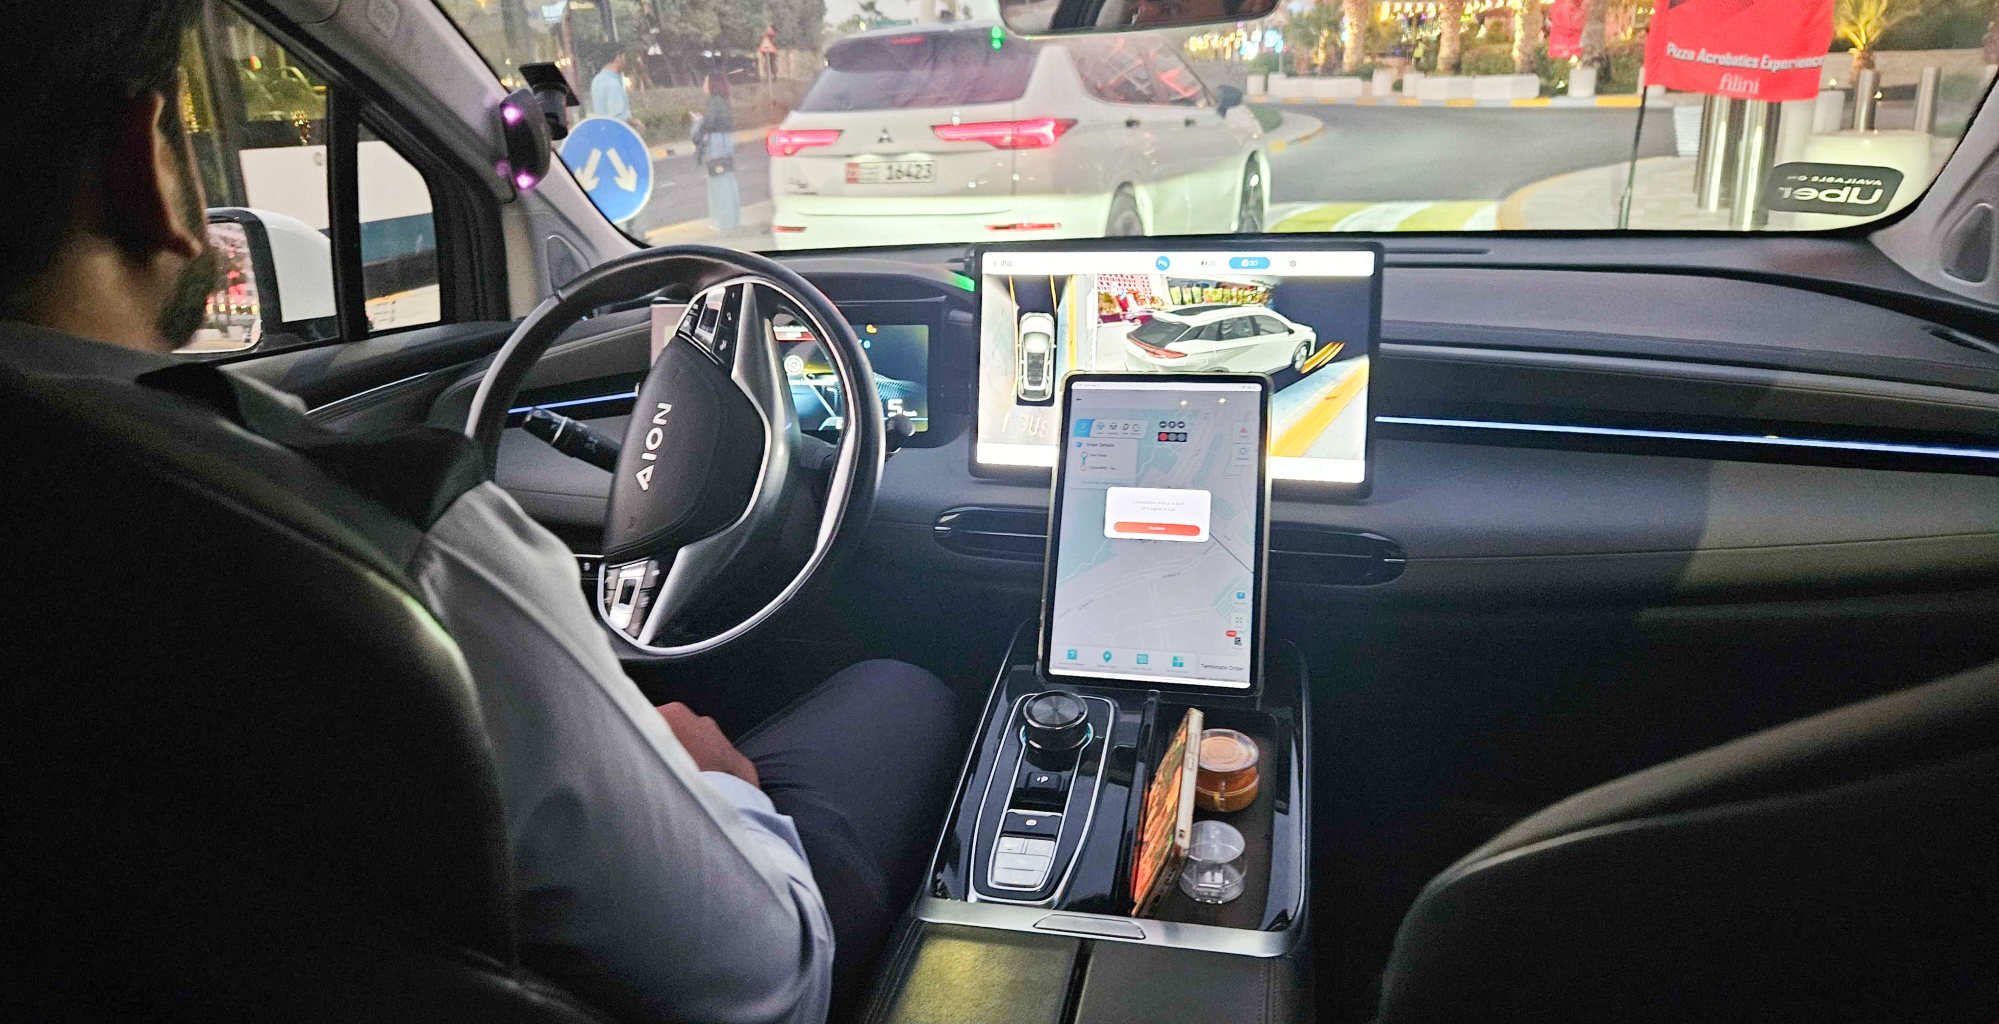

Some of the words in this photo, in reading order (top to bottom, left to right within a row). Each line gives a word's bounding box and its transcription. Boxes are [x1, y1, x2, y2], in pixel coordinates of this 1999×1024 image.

[1666, 42, 1695, 61] Pizza
[1696, 48, 1759, 69] Acrobatics
[1719, 72, 1760, 95] filini
[886, 163, 932, 181] 16423
[887, 398, 903, 418] 5
[635, 402, 672, 491] AION
